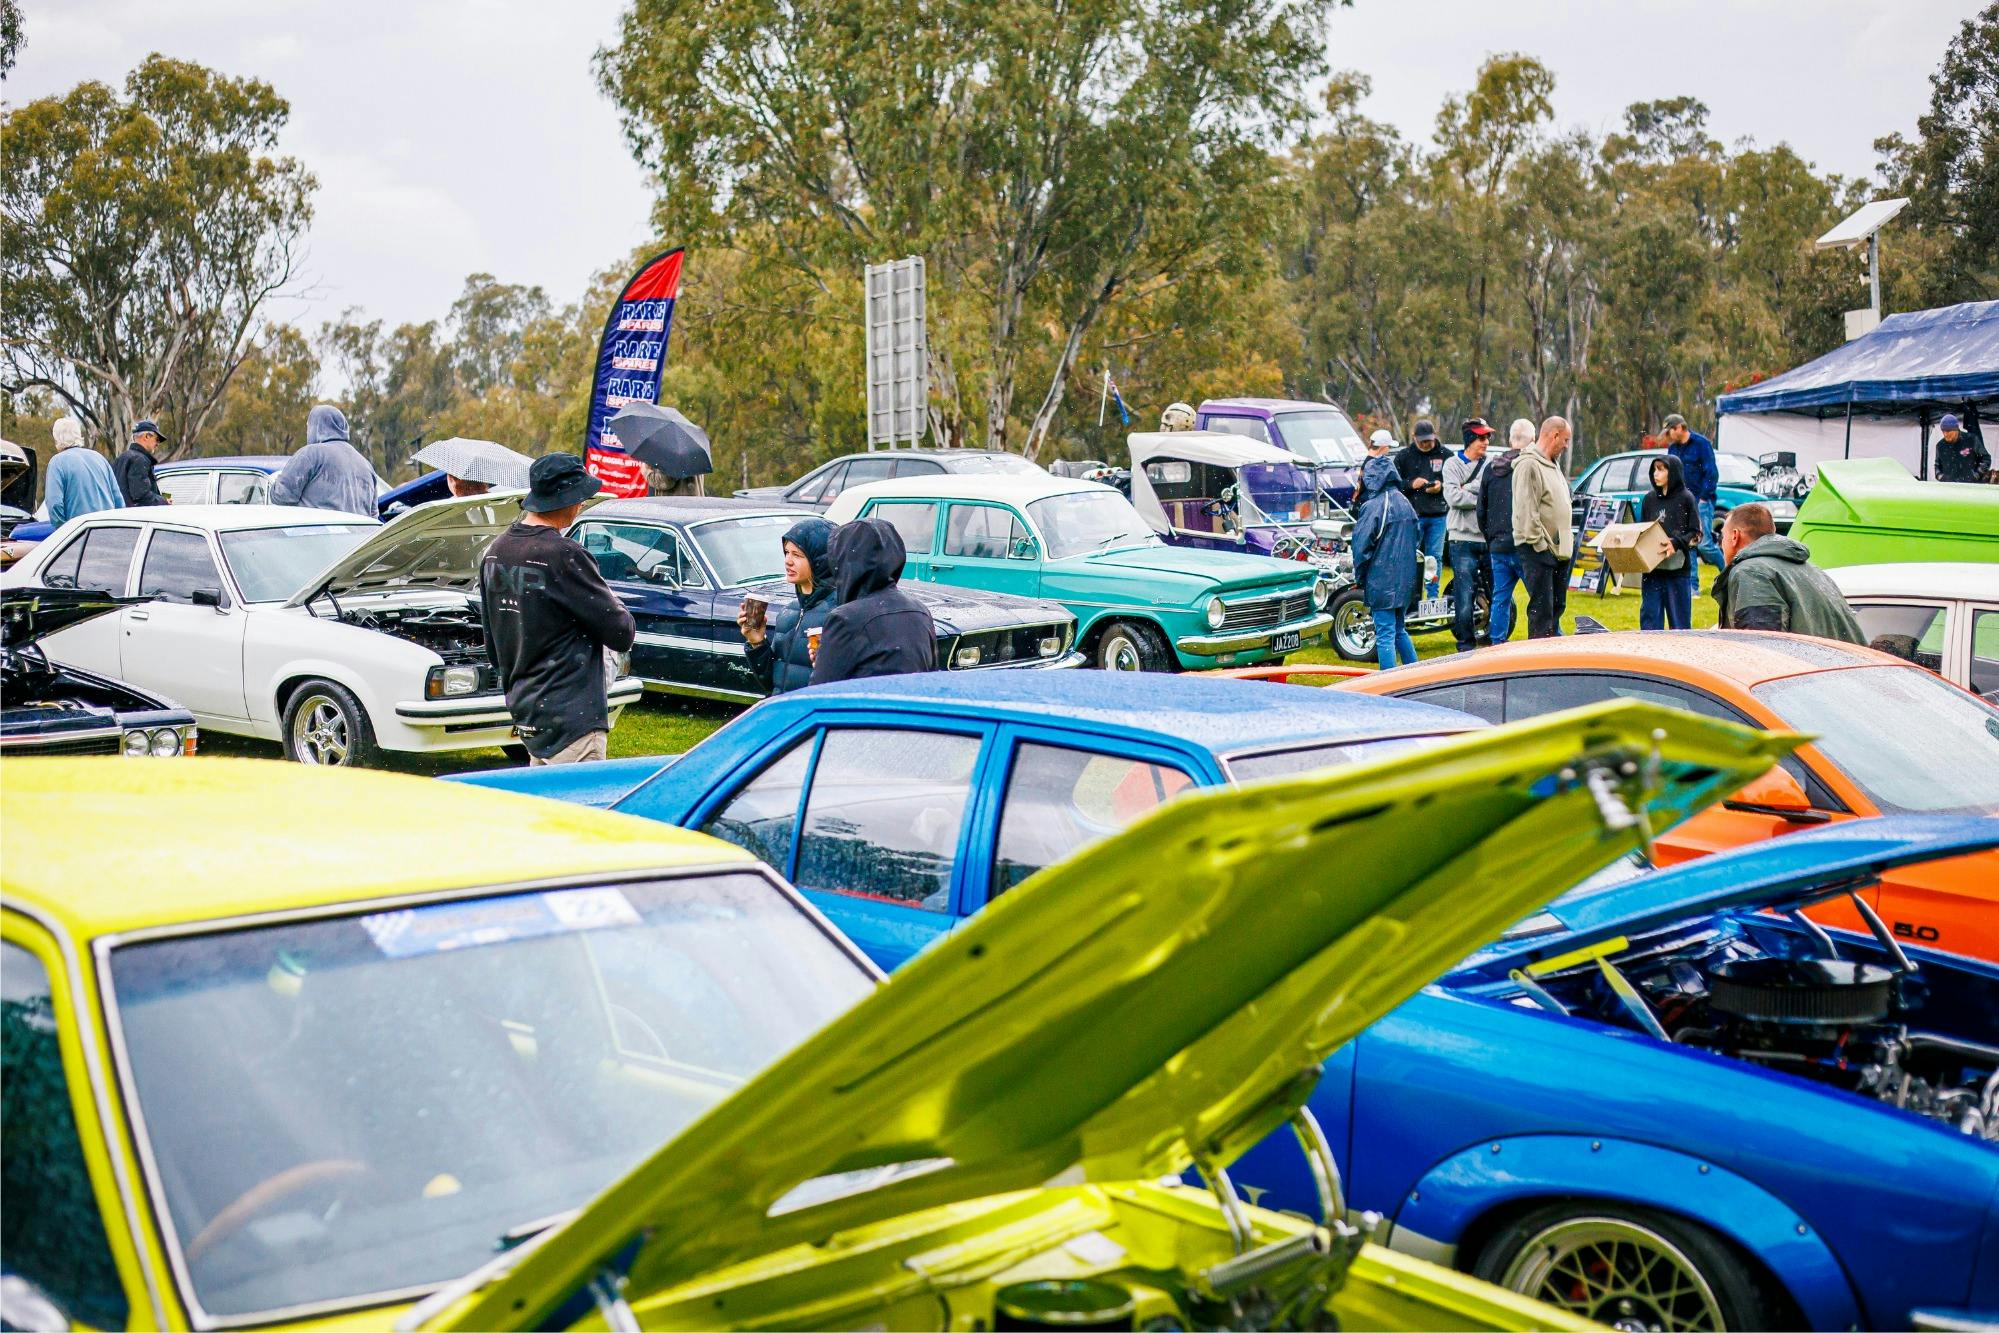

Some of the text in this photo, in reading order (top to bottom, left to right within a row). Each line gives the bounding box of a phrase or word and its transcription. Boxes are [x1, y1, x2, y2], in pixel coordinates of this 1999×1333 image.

[621, 302, 666, 320] RARE
[614, 340, 661, 360] RARE
[608, 378, 654, 400] RARE
